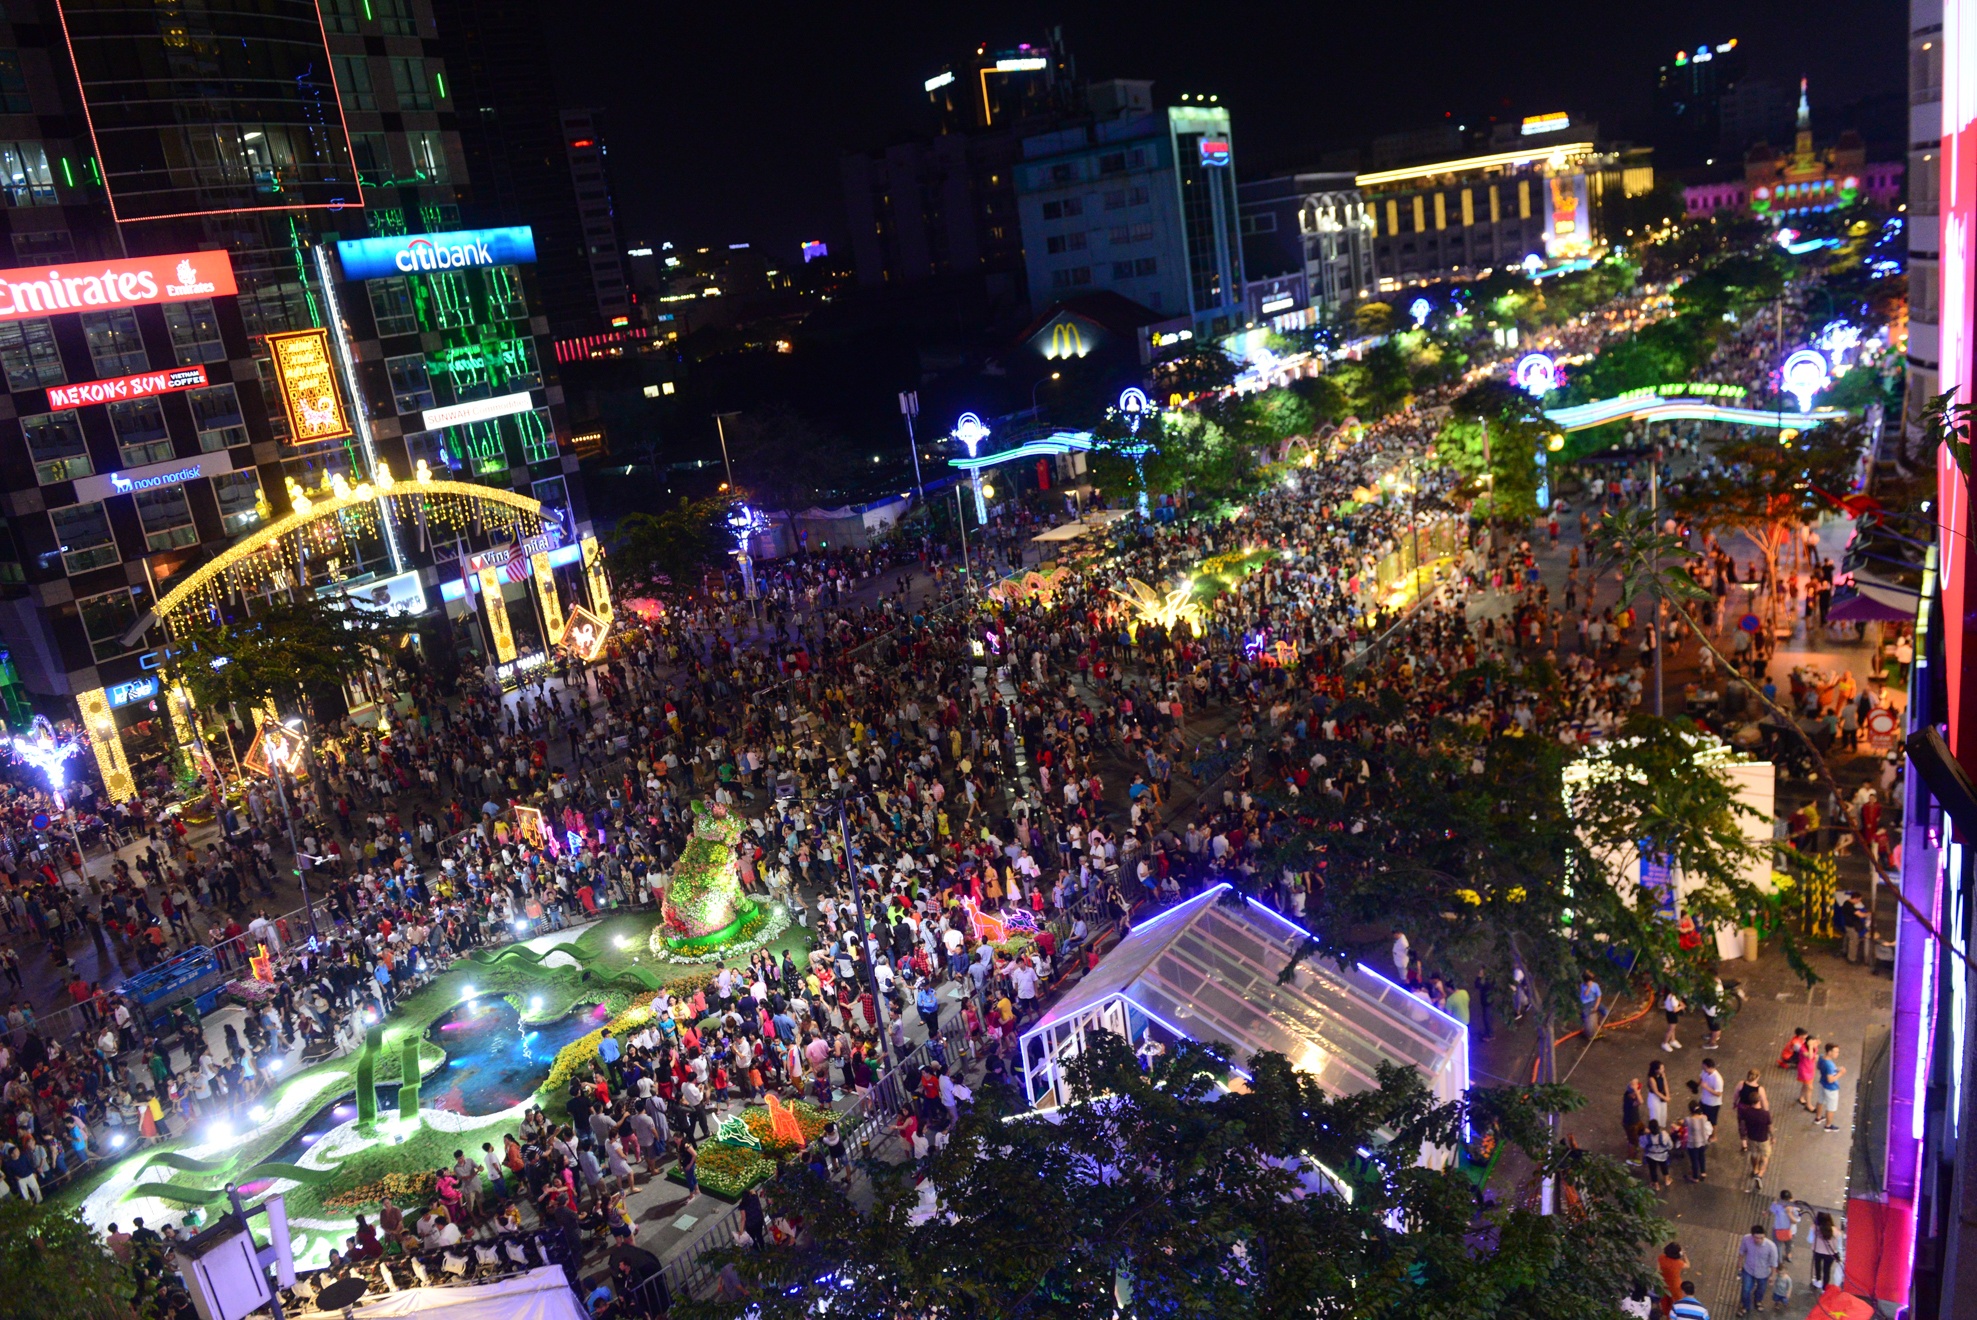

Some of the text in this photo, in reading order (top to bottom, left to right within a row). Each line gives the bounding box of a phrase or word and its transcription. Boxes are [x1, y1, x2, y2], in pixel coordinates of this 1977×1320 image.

[395, 238, 493, 272] citibank
[166, 282, 215, 296] Emirates
[167, 375, 206, 388] COFFEE
[170, 370, 199, 380] VIETNAM
[50, 375, 166, 406] MEKONG SUN
[1718, 384, 1748, 398] 201
[427, 408, 471, 425] SUNWAH
[134, 467, 201, 490] novo nordisk
[480, 535, 549, 566] Vinapital
